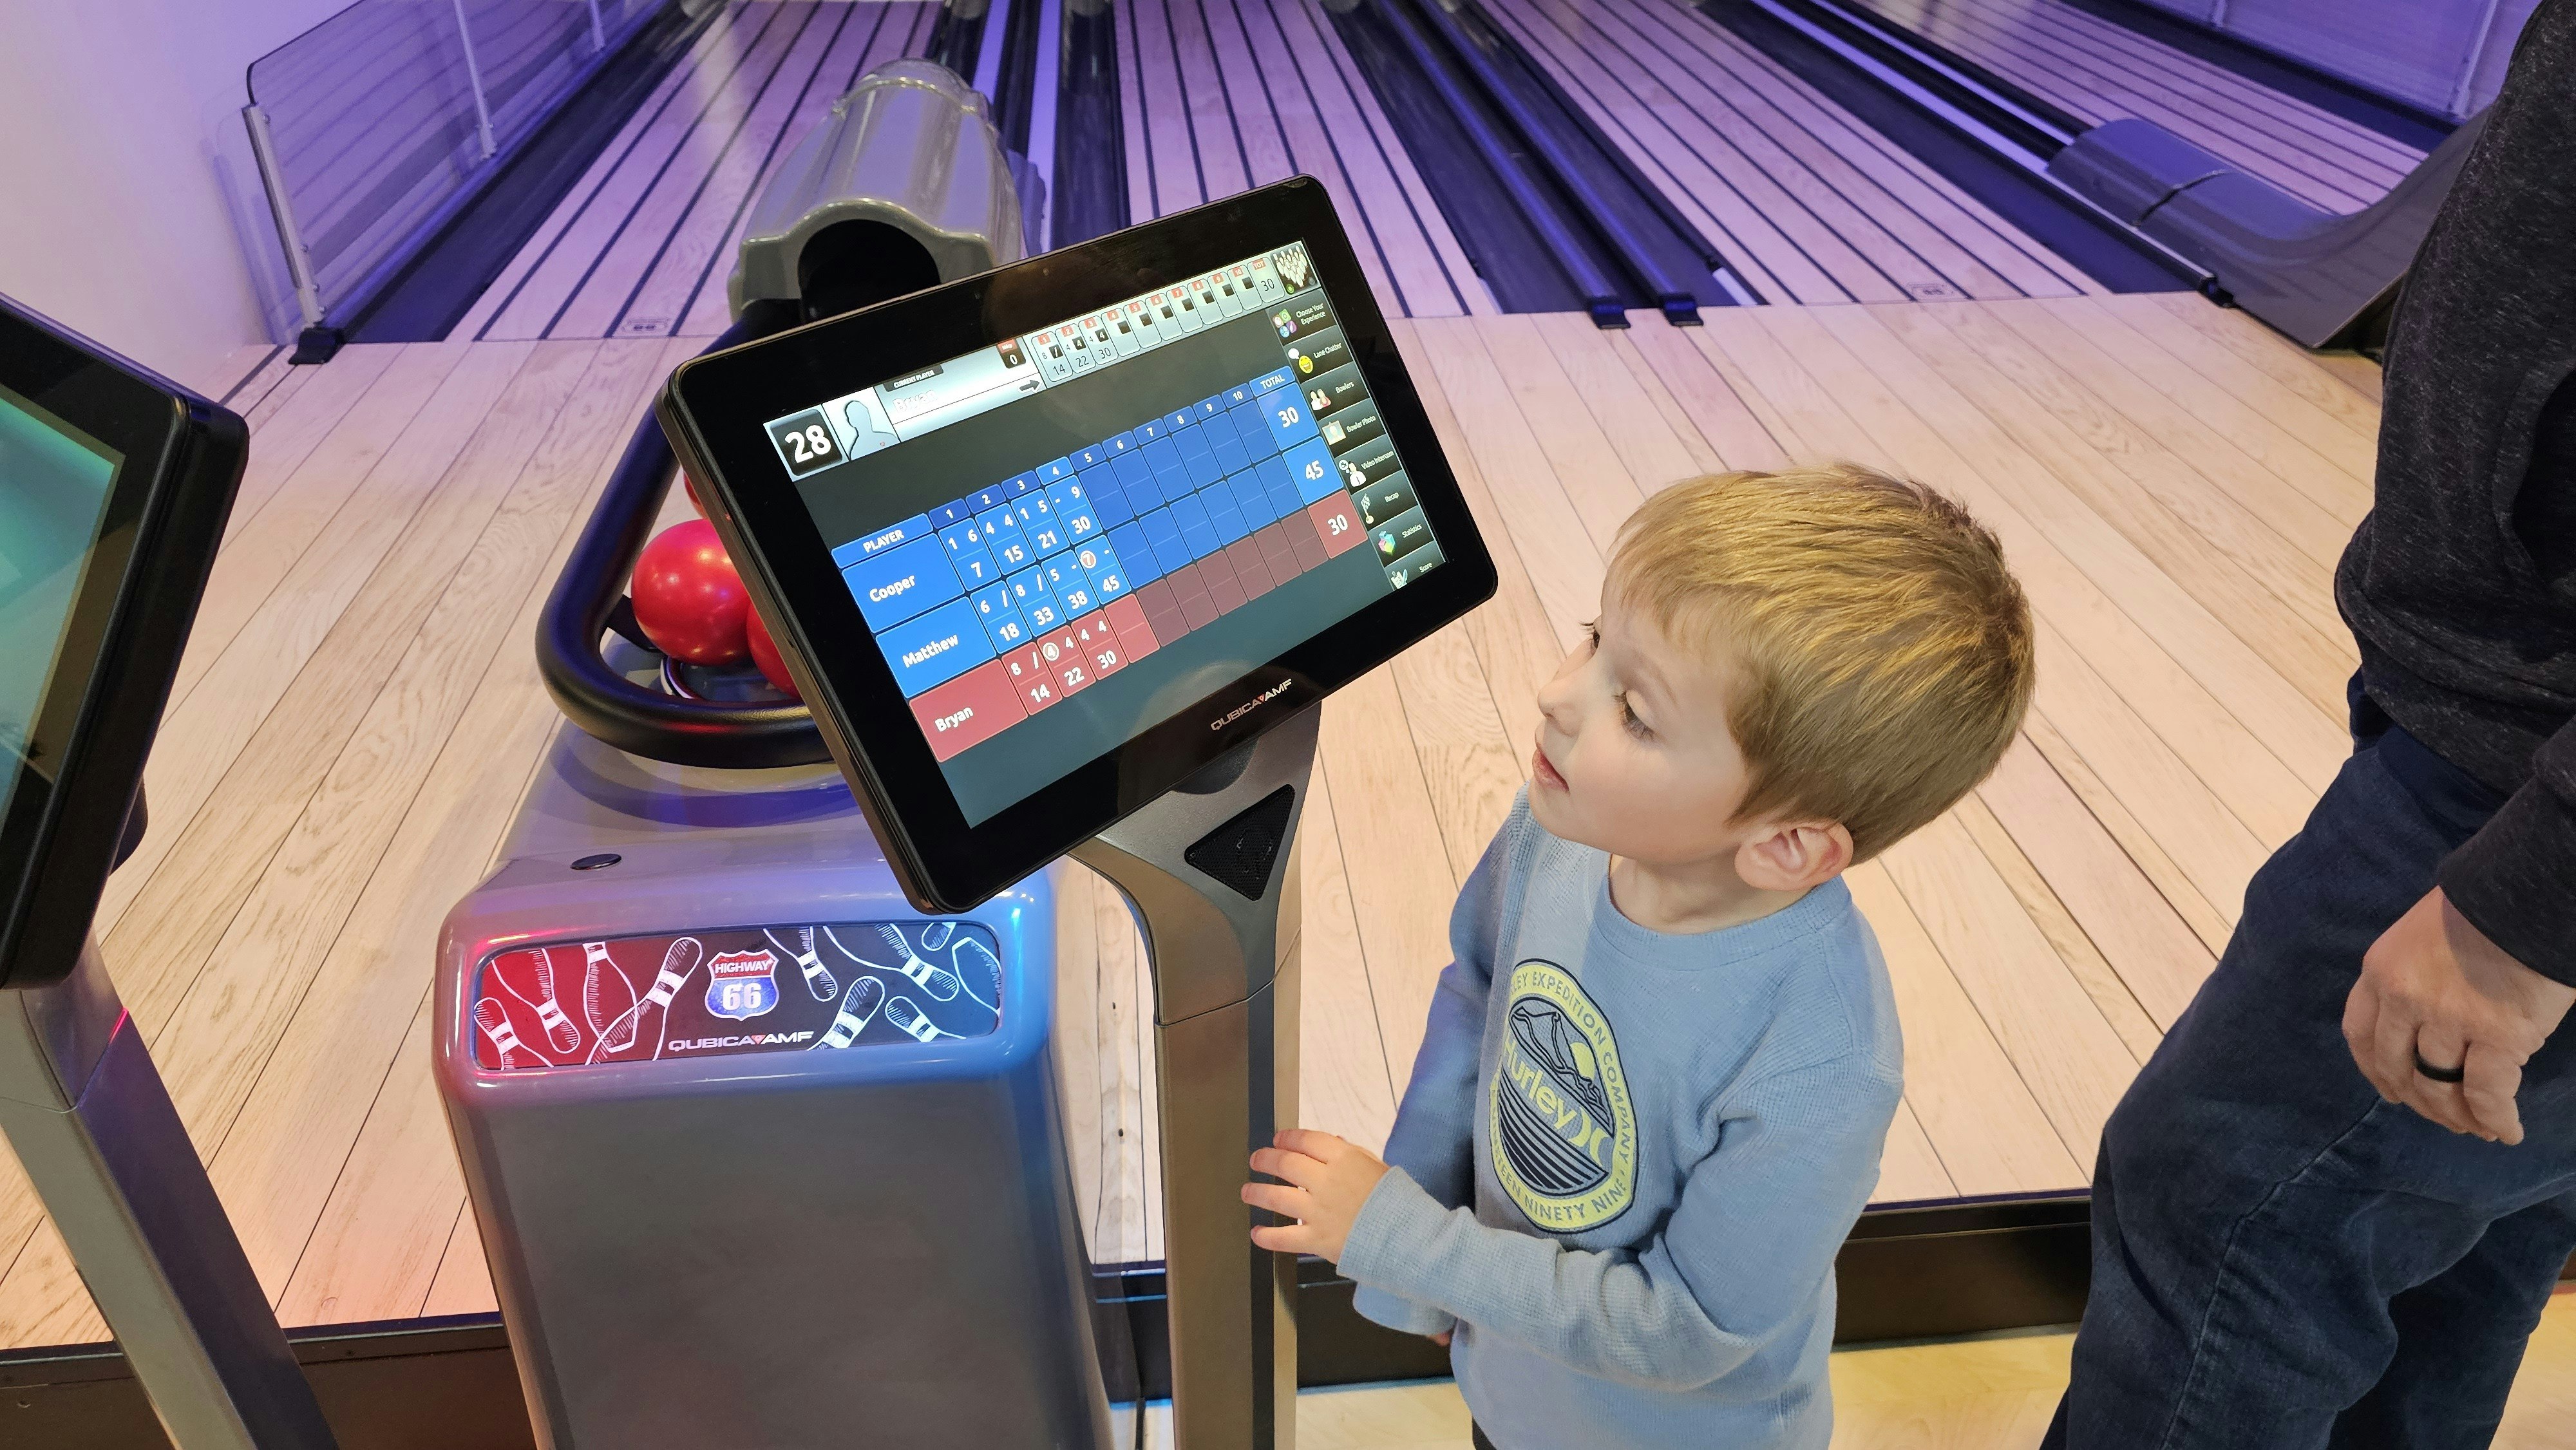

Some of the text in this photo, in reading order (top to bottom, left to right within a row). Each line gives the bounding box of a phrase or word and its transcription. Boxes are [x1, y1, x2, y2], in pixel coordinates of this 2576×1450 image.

[1253, 261, 1265, 270] TOT
[1296, 302, 1324, 319] Choose Your
[1300, 310, 1326, 325] Experience
[1053, 278, 1275, 375] 14 22 30 30
[1076, 339, 1083, 348] 4
[1099, 330, 1106, 339] 4
[1009, 354, 1018, 365] 0
[1313, 343, 1342, 359] Lane Chatter
[1335, 381, 1354, 394] Bowlers
[893, 390, 937, 413] Bryan
[1346, 415, 1376, 433] Bowler Photo
[784, 424, 832, 464] 28
[863, 373, 1285, 553] PLAYER 1 2 3 4 5 6 7 8 9 10 TOTAL
[1361, 451, 1394, 470] Video Intercom
[970, 406, 1299, 578] 7 15 21 30 30
[1384, 491, 1399, 504] Recap
[948, 537, 958, 551] 1
[967, 529, 978, 542] 6
[985, 522, 995, 534] 4
[1004, 514, 1014, 527] 4
[1019, 507, 1030, 520] 1
[1037, 500, 1048, 513] 5
[1070, 485, 1081, 499] 9
[1401, 523, 1422, 538] Statistics
[999, 460, 1323, 642] 18 33 38 45 45
[1419, 562, 1433, 573] Score
[869, 575, 916, 603] Cooper
[980, 599, 990, 614] 6
[1015, 584, 1026, 598] 8
[1049, 568, 1060, 581] 5
[1030, 514, 1348, 703] 14 22 30 30
[902, 634, 959, 668] Matthew
[1010, 662, 1022, 675] 8
[1065, 636, 1074, 648] 4
[1081, 628, 1090, 642] 4
[1097, 619, 1107, 632] 4
[934, 706, 974, 733] Bryan
[714, 960, 770, 974] HIGHWAY
[722, 982, 762, 1011] 66
[1533, 971, 1606, 1046] EXPEDITION
[1604, 1051, 1629, 1164] COMPANY
[1524, 1194, 1584, 1221] NINETY
[1591, 1178, 1627, 1213] NINE
